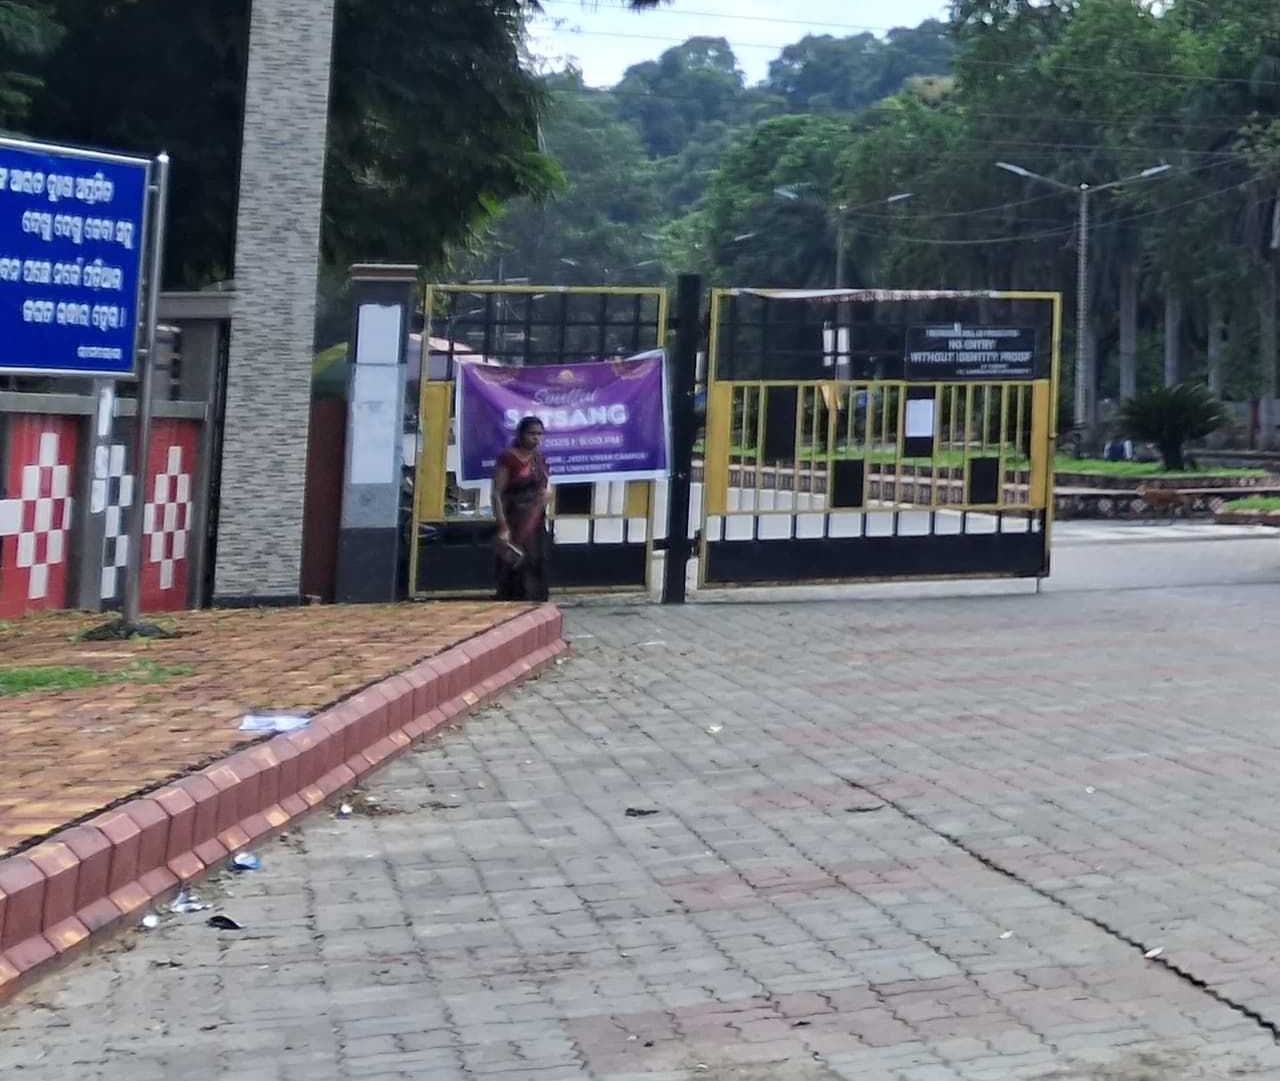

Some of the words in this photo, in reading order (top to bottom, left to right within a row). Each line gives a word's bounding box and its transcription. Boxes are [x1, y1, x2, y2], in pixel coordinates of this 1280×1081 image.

[910, 351, 955, 363] WITHOUT
[1000, 351, 1032, 363] PROOF
[504, 403, 629, 431] STSANG
